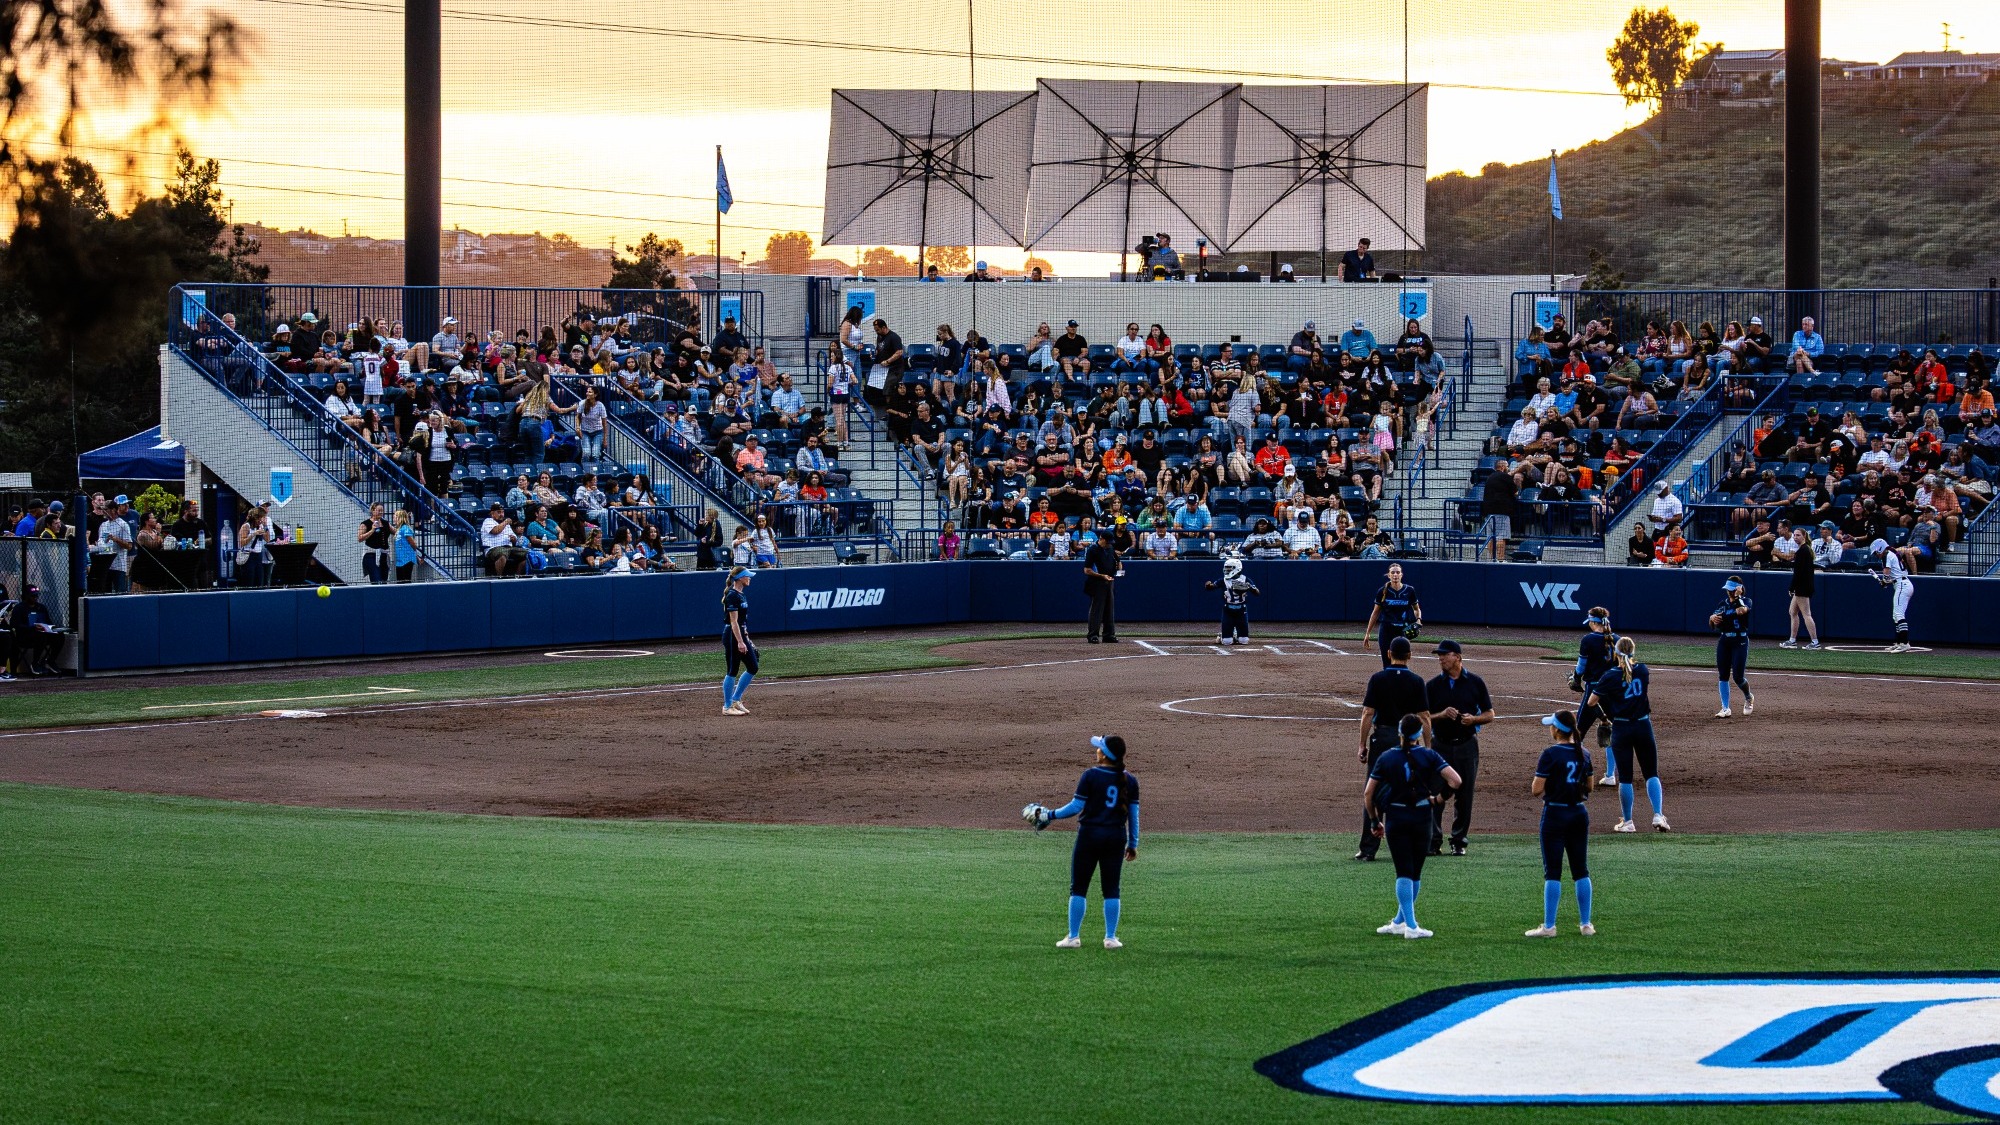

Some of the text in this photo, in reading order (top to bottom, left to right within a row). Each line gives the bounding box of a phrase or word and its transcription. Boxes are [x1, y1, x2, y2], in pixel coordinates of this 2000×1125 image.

[1409, 302, 1418, 314] 2
[1543, 310, 1551, 323] 3
[368, 362, 375, 374] 0
[278, 482, 284, 496] 1
[790, 587, 885, 611] SAN DIEGO
[1519, 582, 1581, 611] WCC
[1733, 619, 1740, 629] 5
[1621, 678, 1643, 699] 20
[1105, 785, 1119, 808] 9
